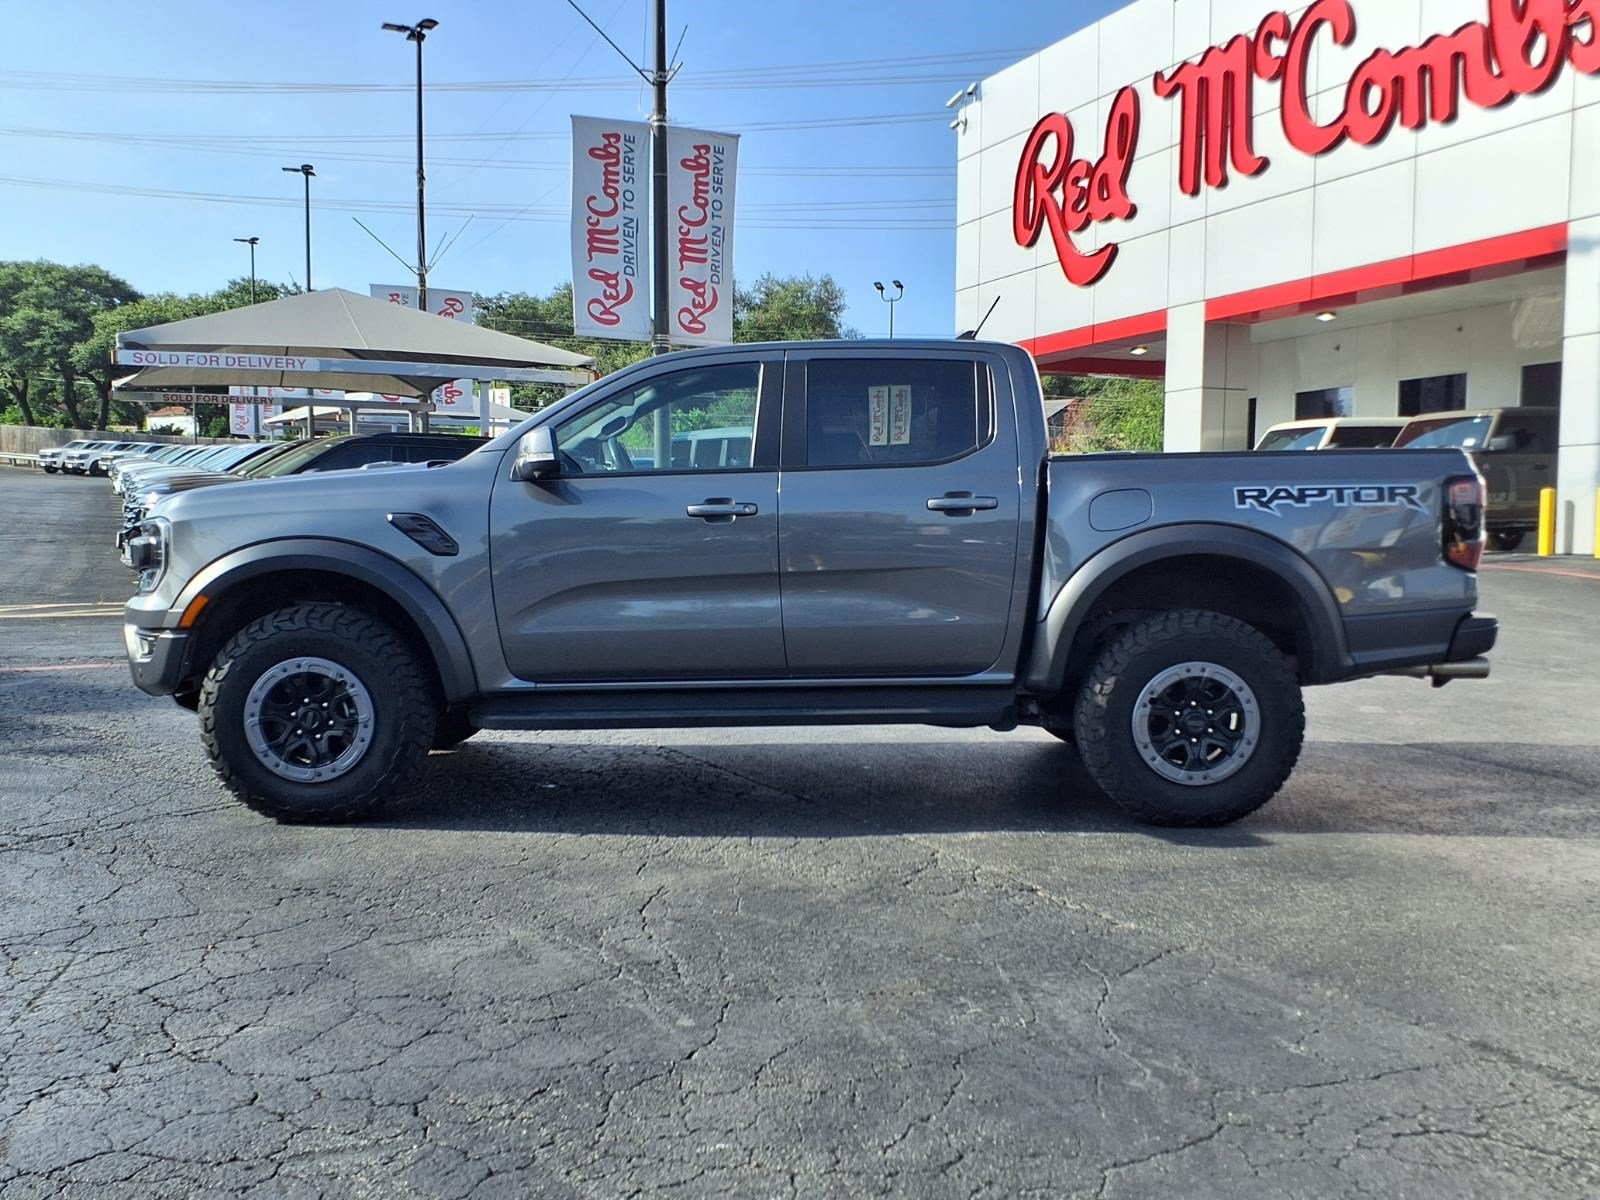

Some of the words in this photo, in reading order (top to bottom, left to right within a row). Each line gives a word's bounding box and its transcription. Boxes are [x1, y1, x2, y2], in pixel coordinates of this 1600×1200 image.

[623, 133, 635, 184] SERVE
[712, 145, 724, 194] SERVE
[587, 132, 621, 262] McCombs
[623, 189, 635, 211] TO
[678, 144, 711, 271] McCombs
[711, 200, 723, 220] TO
[1013, 85, 1139, 286] Red
[623, 217, 635, 277] DRIVEN
[711, 229, 723, 284] DRIVEN
[438, 297, 464, 319] Re
[587, 268, 633, 326] Red
[678, 277, 718, 334] Red
[132, 352, 179, 365] SOLD
[185, 354, 220, 366] FOR
[225, 356, 306, 369] DELIVERY
[162, 393, 193, 402] SOLD
[196, 394, 219, 403] FOR
[221, 395, 275, 405] DELIVERY
[1233, 483, 1430, 517] RAPTOR
